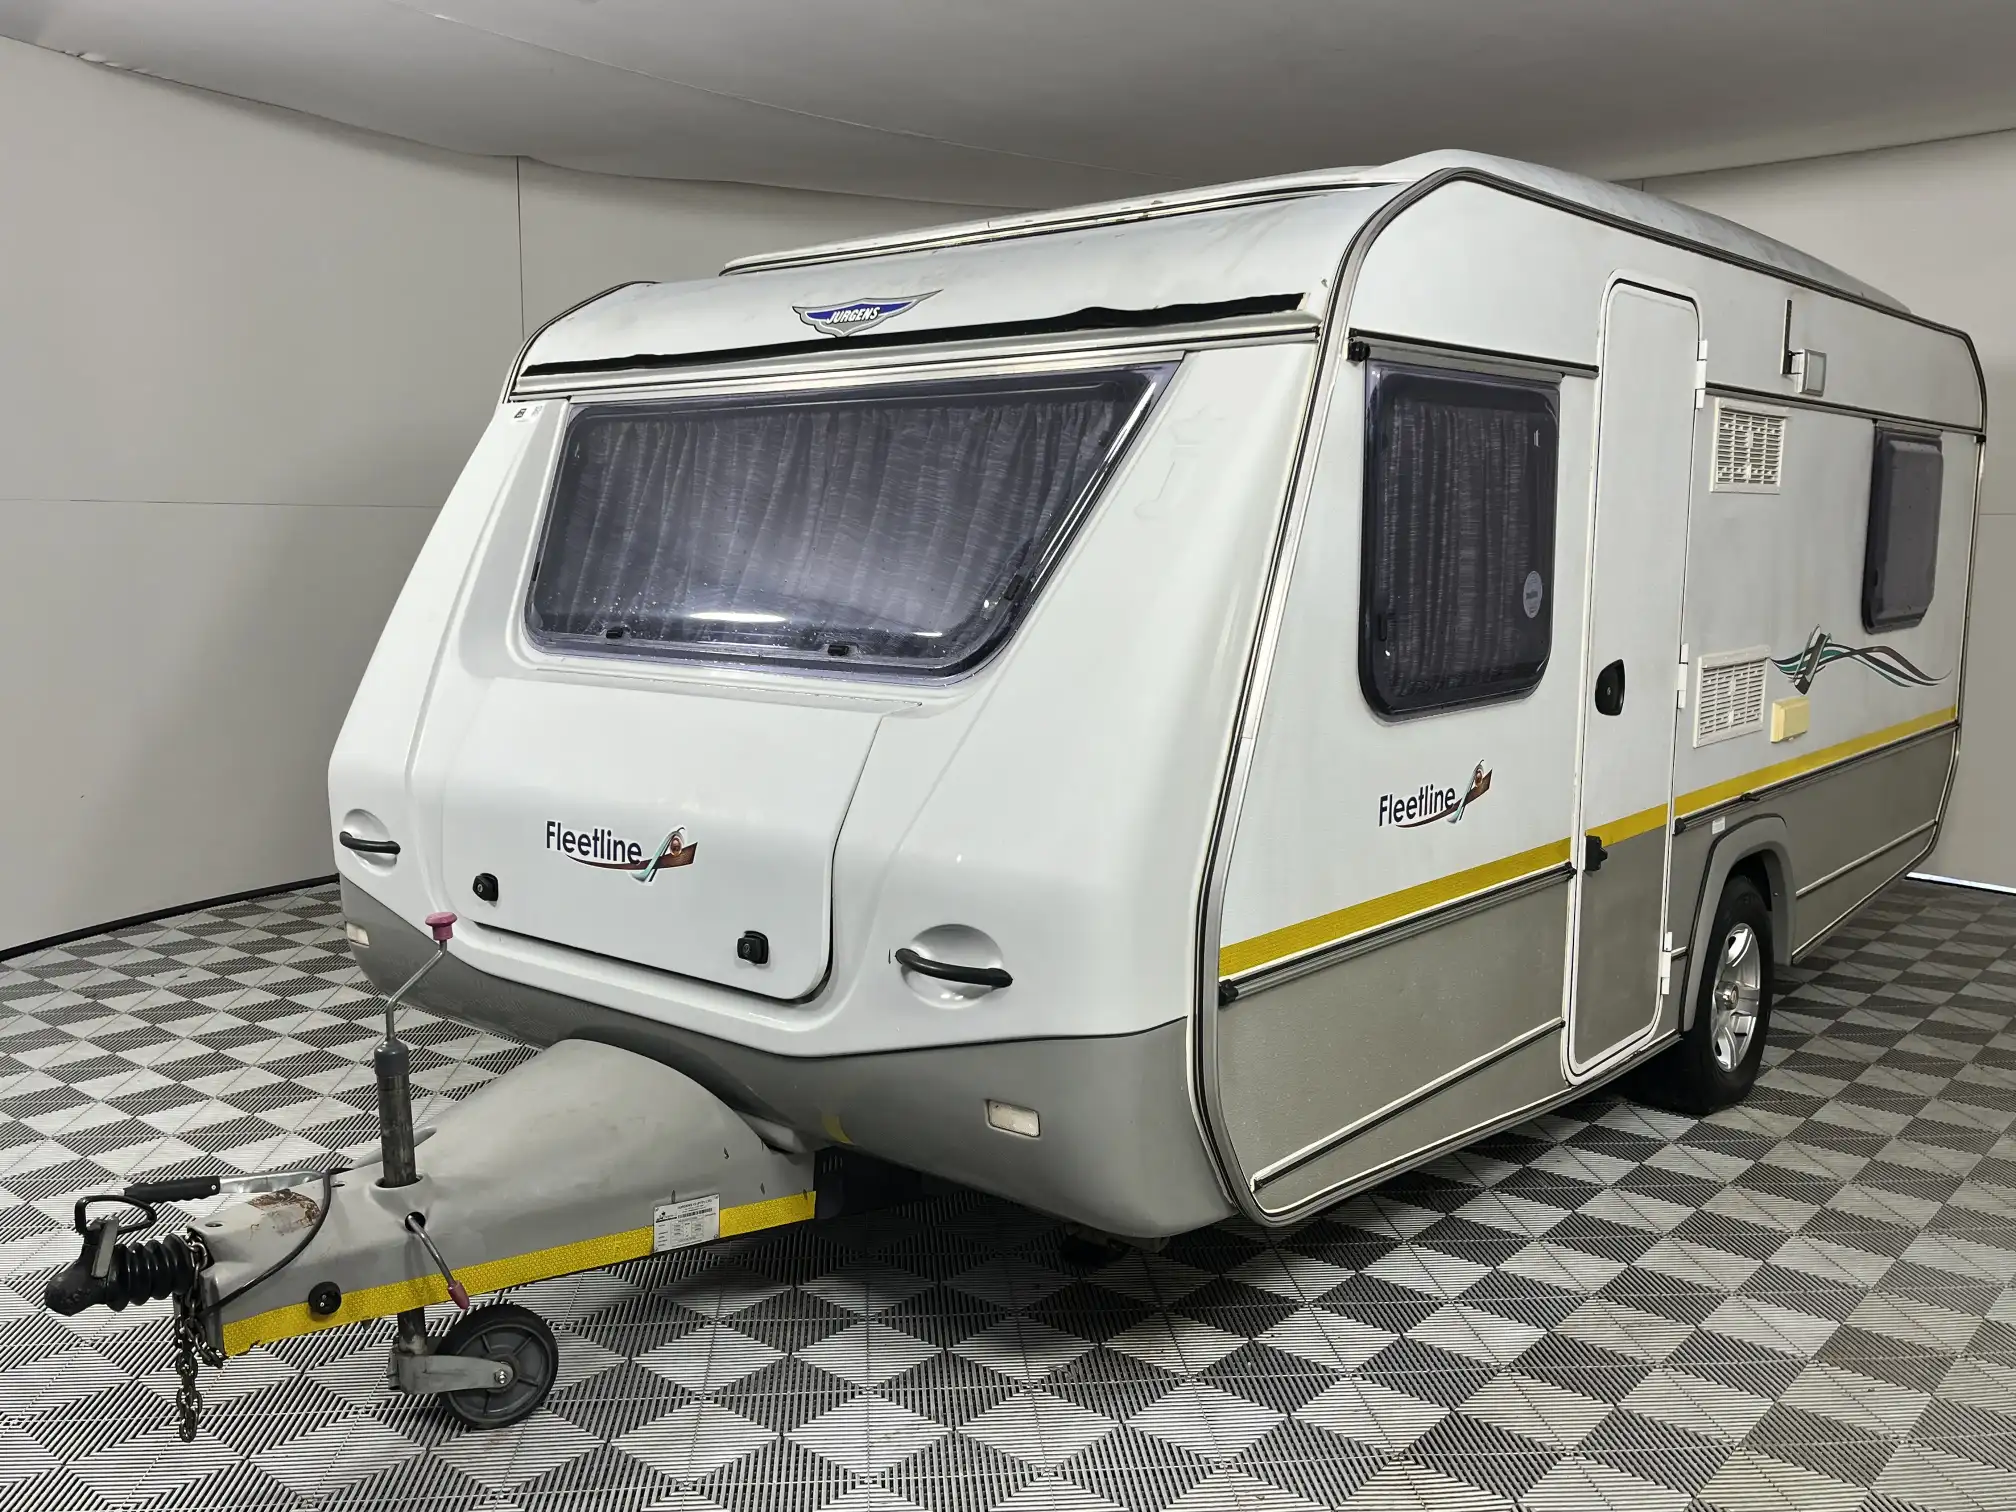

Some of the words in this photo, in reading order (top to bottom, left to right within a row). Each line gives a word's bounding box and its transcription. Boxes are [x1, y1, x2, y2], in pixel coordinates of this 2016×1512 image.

[826, 306, 881, 324] JURGENS
[1379, 783, 1456, 827] Fleetline
[546, 820, 642, 865] Fleetline
